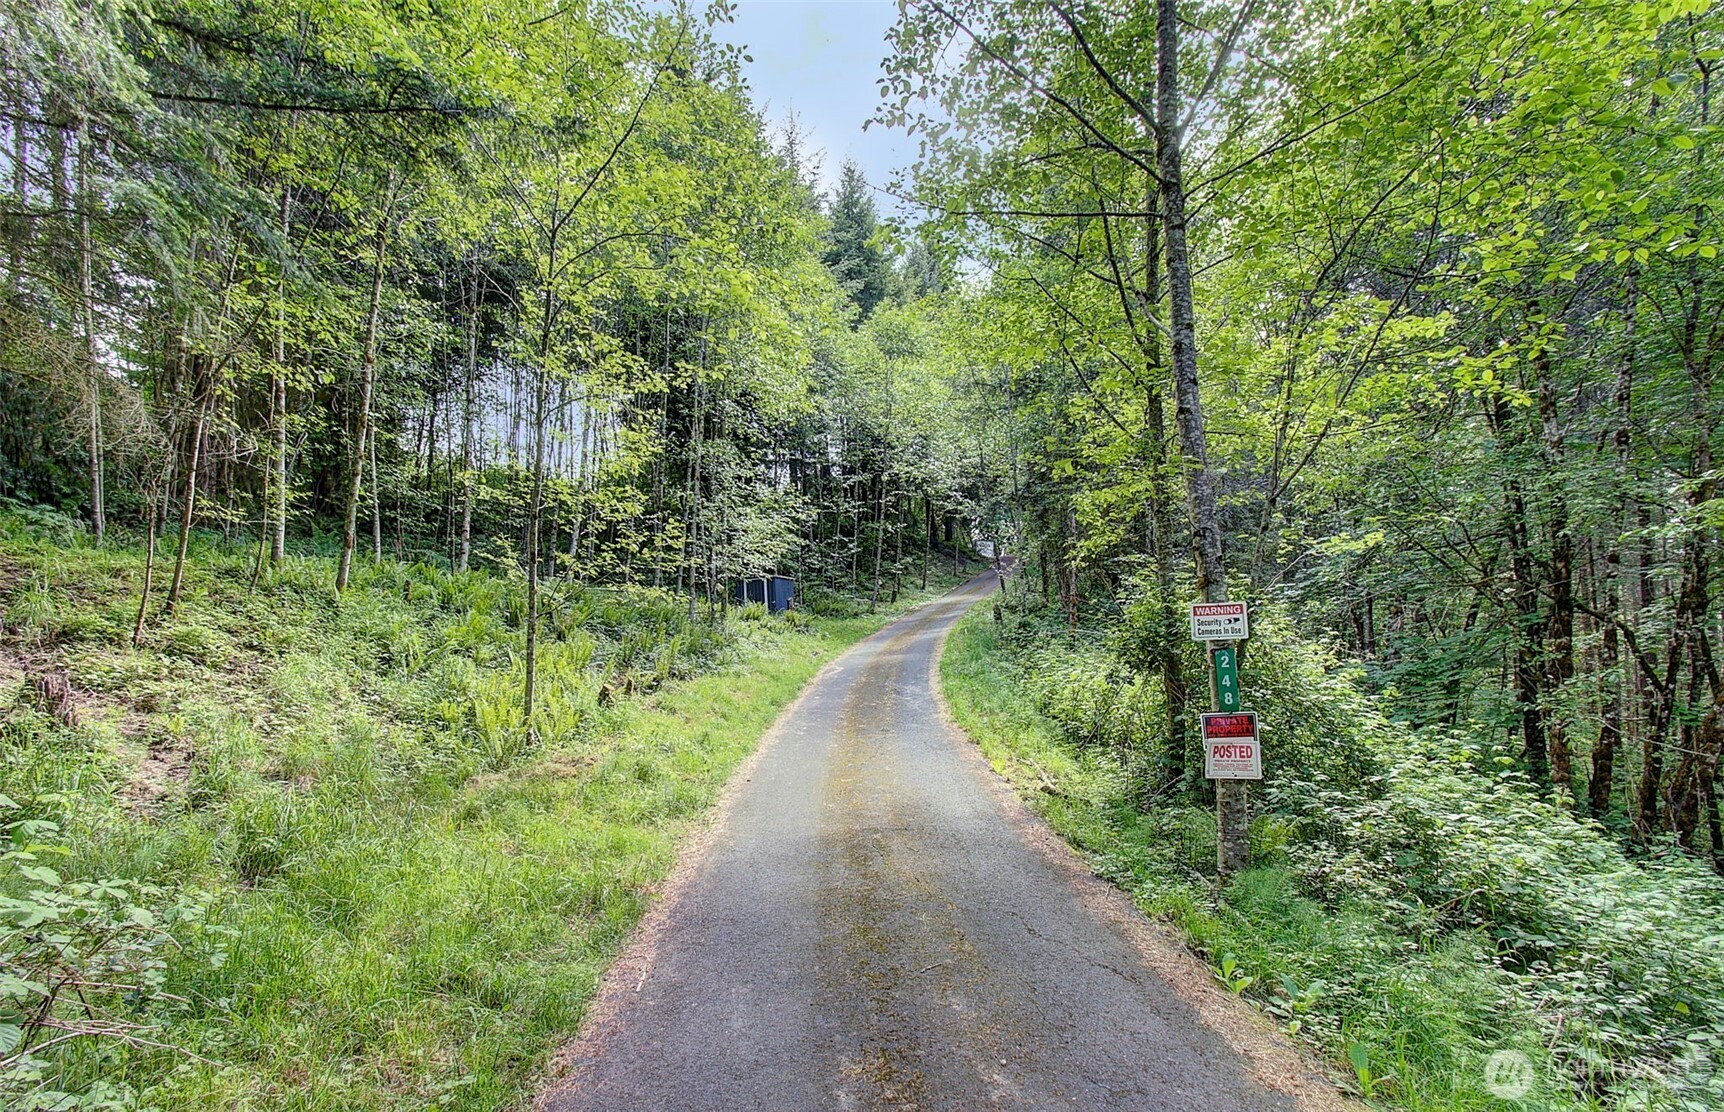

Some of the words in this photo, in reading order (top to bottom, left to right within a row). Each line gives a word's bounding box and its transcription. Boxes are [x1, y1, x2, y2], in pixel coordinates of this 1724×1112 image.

[1195, 605, 1241, 615] WARNING
[1197, 618, 1222, 627] Security
[1197, 628, 1222, 636] Cameras
[1230, 626, 1241, 634] Use
[1210, 716, 1249, 725] PRIVATE
[1207, 724, 1253, 733] PROPERTY
[1213, 745, 1253, 759] POSTED
